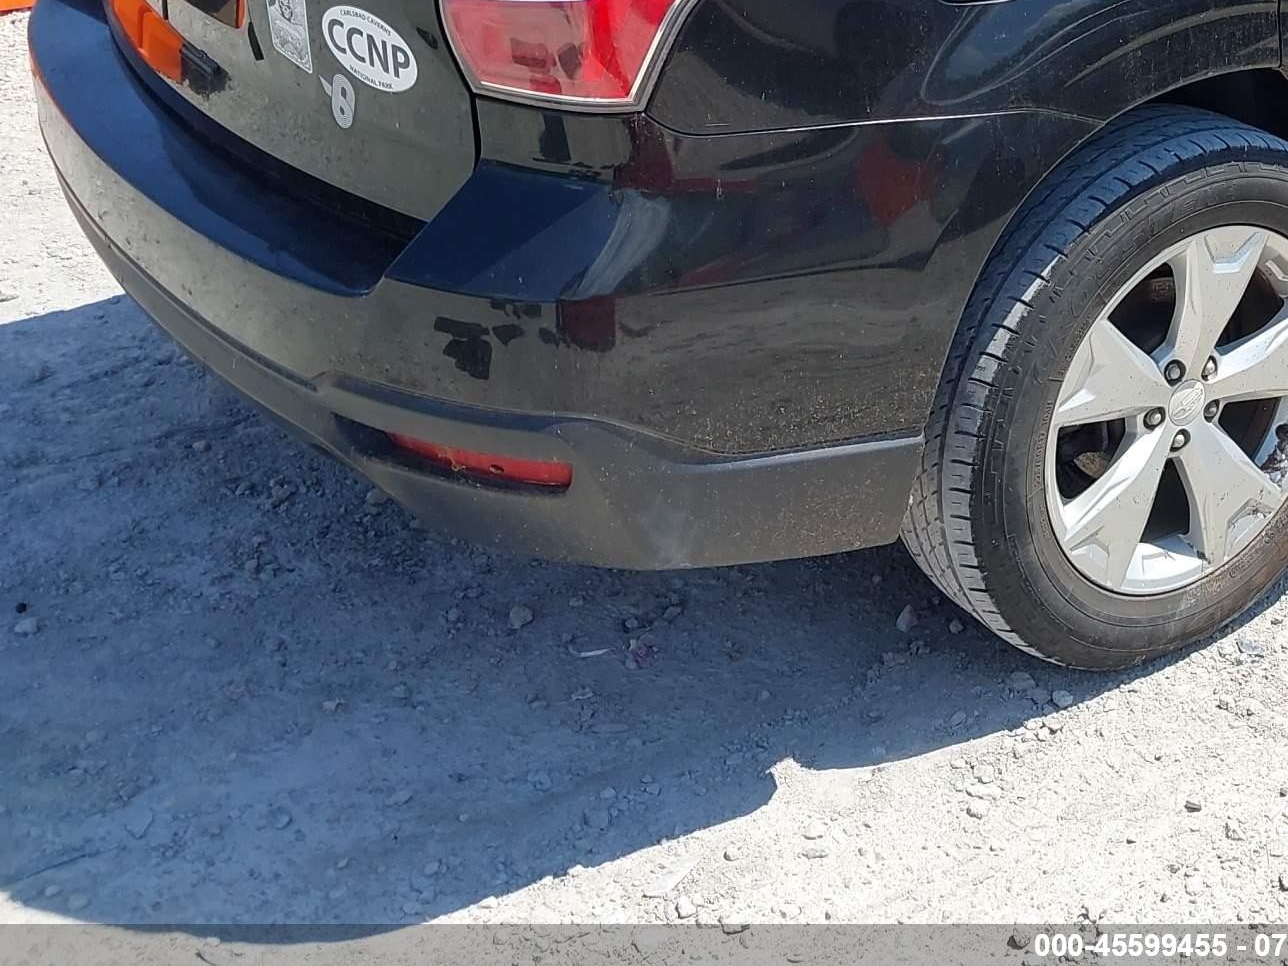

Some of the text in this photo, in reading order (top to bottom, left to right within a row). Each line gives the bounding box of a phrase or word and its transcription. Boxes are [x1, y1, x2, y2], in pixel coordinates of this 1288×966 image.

[340, 9, 392, 36] CARLSBAD CAVERNS
[327, 18, 410, 80] CCNP
[349, 64, 393, 90] NATIONAL PARK
